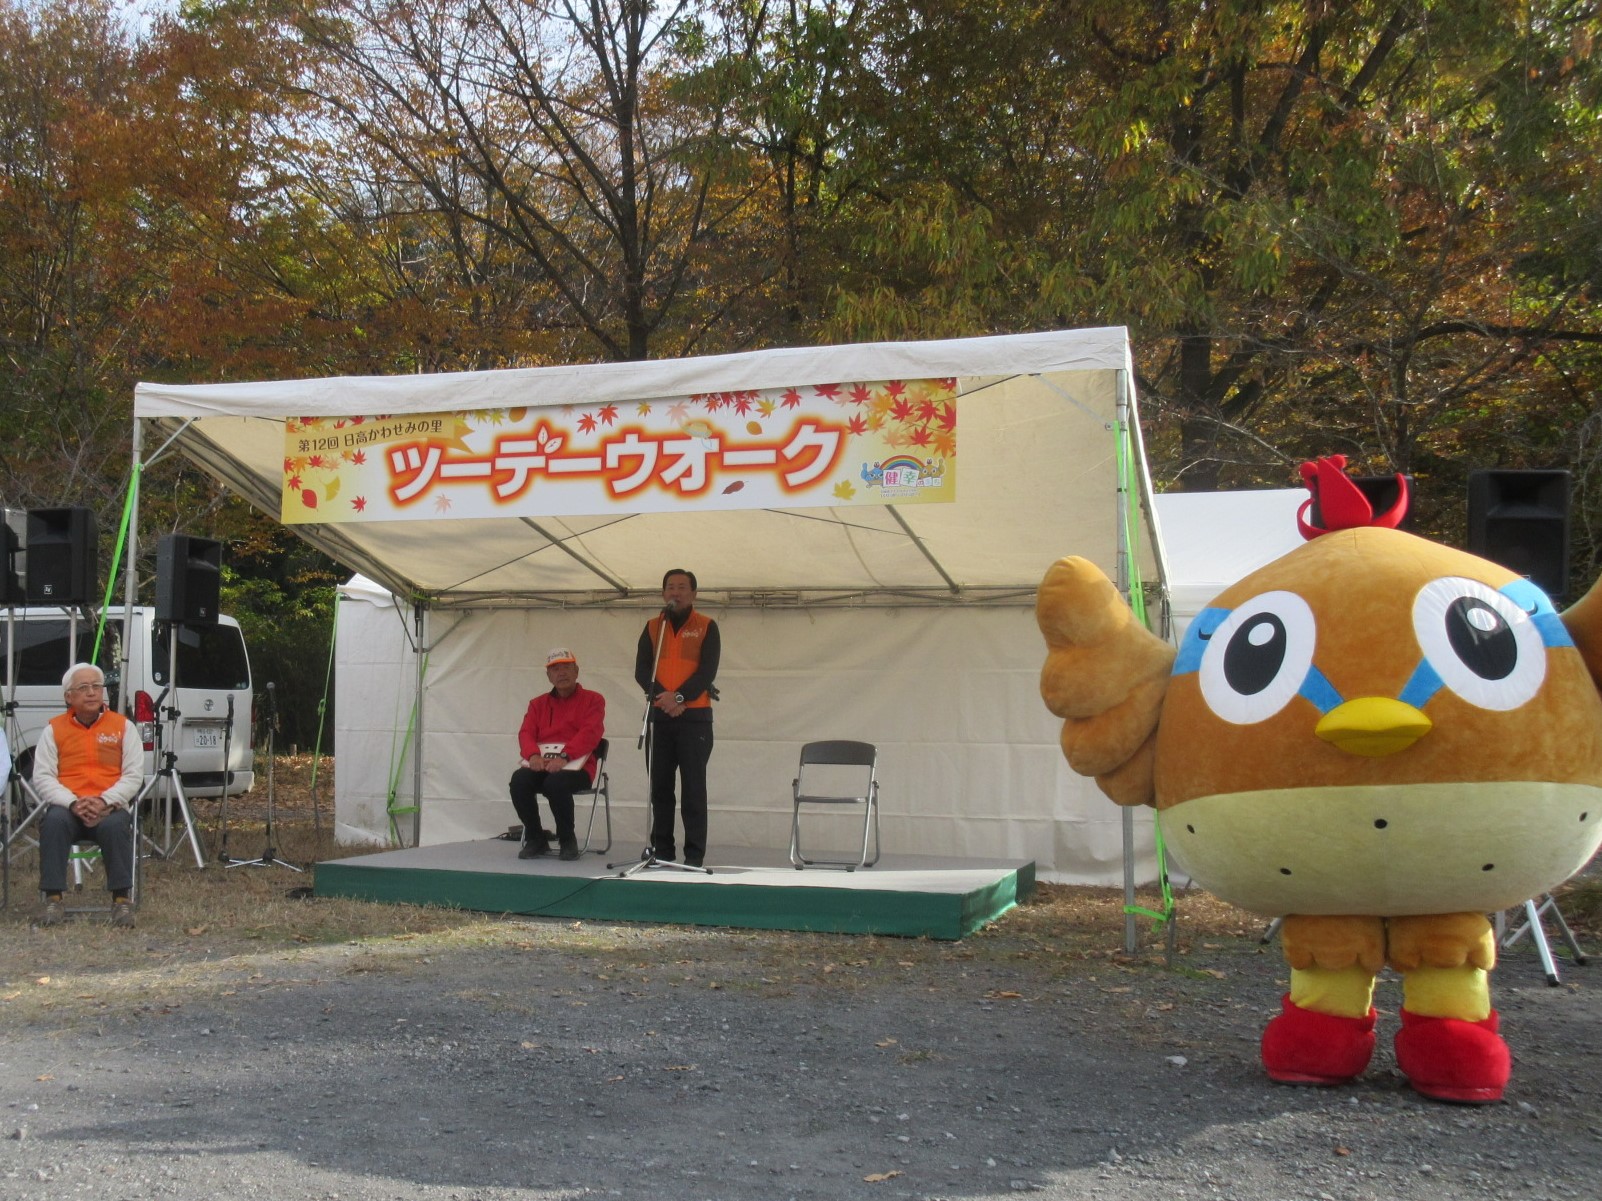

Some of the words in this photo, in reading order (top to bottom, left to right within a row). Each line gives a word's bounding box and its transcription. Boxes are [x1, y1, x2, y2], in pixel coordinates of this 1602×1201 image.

[298, 436, 339, 453] 第12回
[344, 420, 443, 447] 日高かわせみの里
[389, 423, 841, 502] ツーデーウオーク
